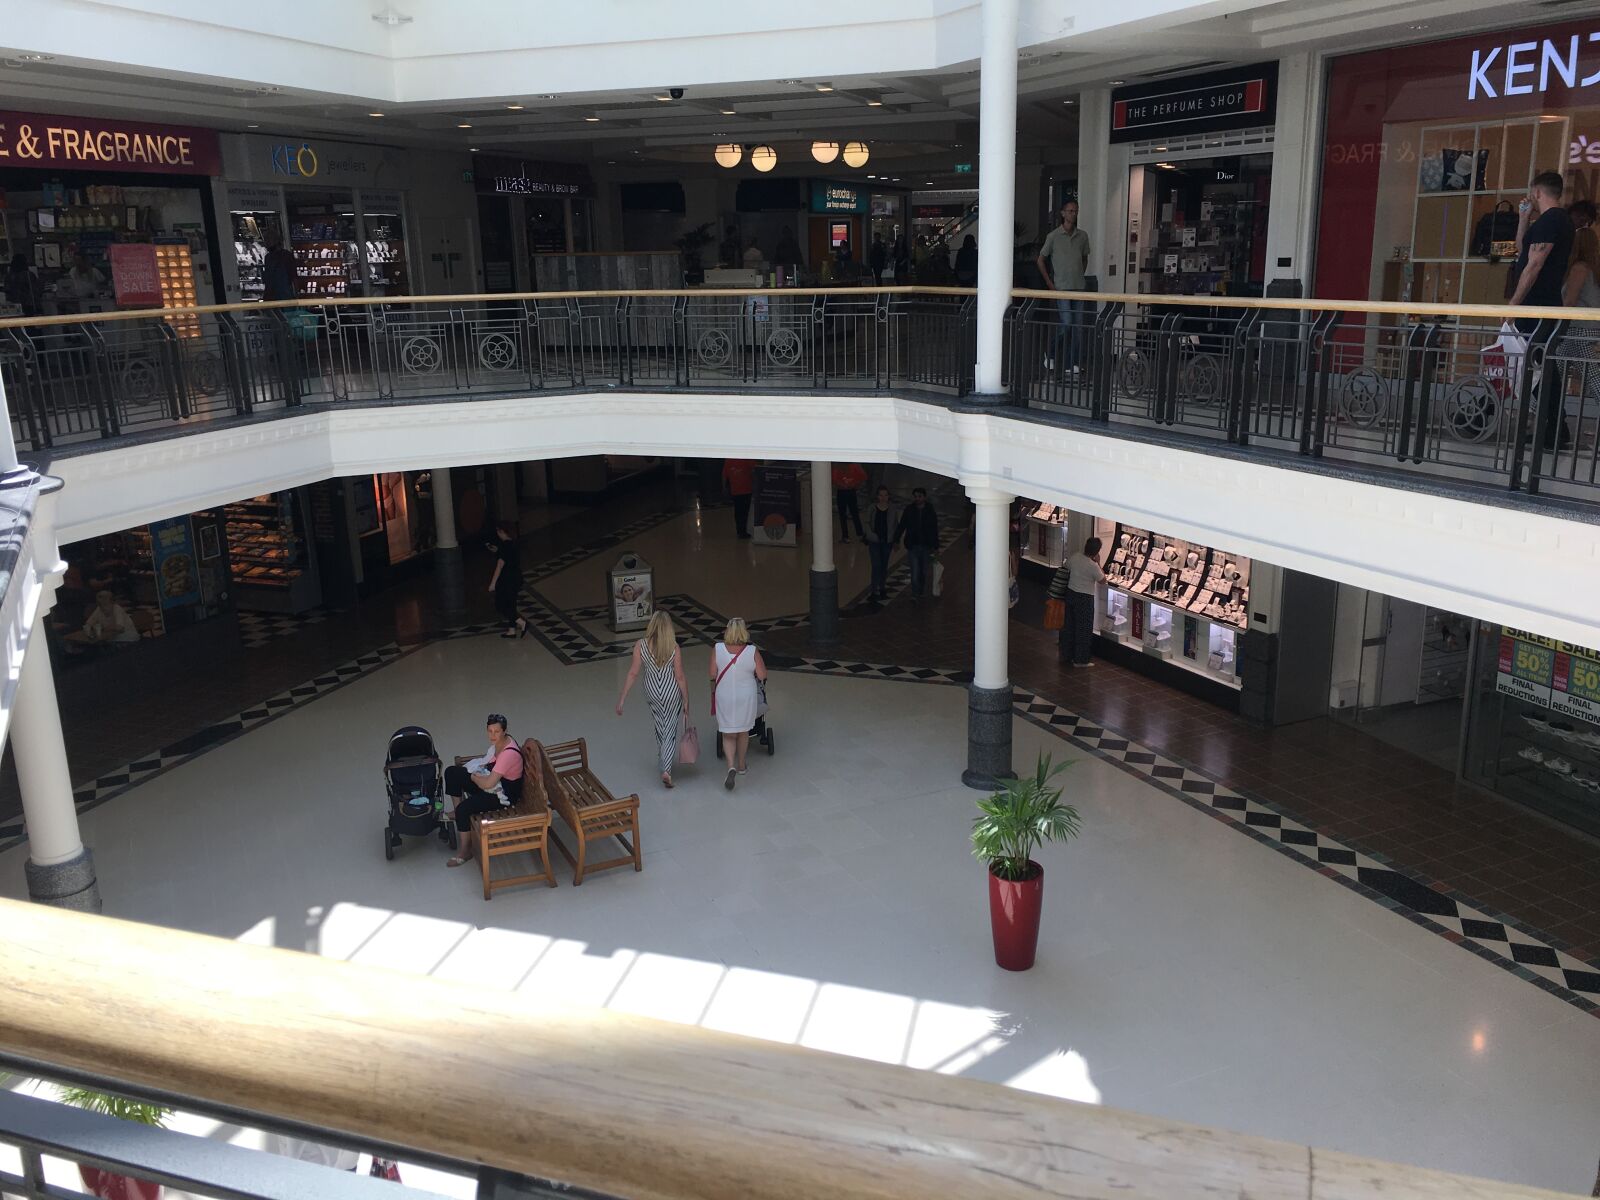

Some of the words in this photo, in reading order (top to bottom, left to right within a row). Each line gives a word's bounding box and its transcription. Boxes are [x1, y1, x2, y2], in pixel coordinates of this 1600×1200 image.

[1128, 107, 1147, 119] THE
[1153, 98, 1203, 116] PERFUME
[1210, 92, 1243, 108] SHOP
[16, 124, 43, 159] &
[47, 127, 194, 165] FRAGRANCE
[271, 142, 318, 177] KEO
[327, 156, 367, 175] jewellers
[1217, 171, 1235, 181] Dior
[122, 281, 154, 293] SALE
[1512, 677, 1535, 691] FINAL
[1498, 684, 1548, 706] REDUCTIONS
[1568, 696, 1592, 710] FINAL
